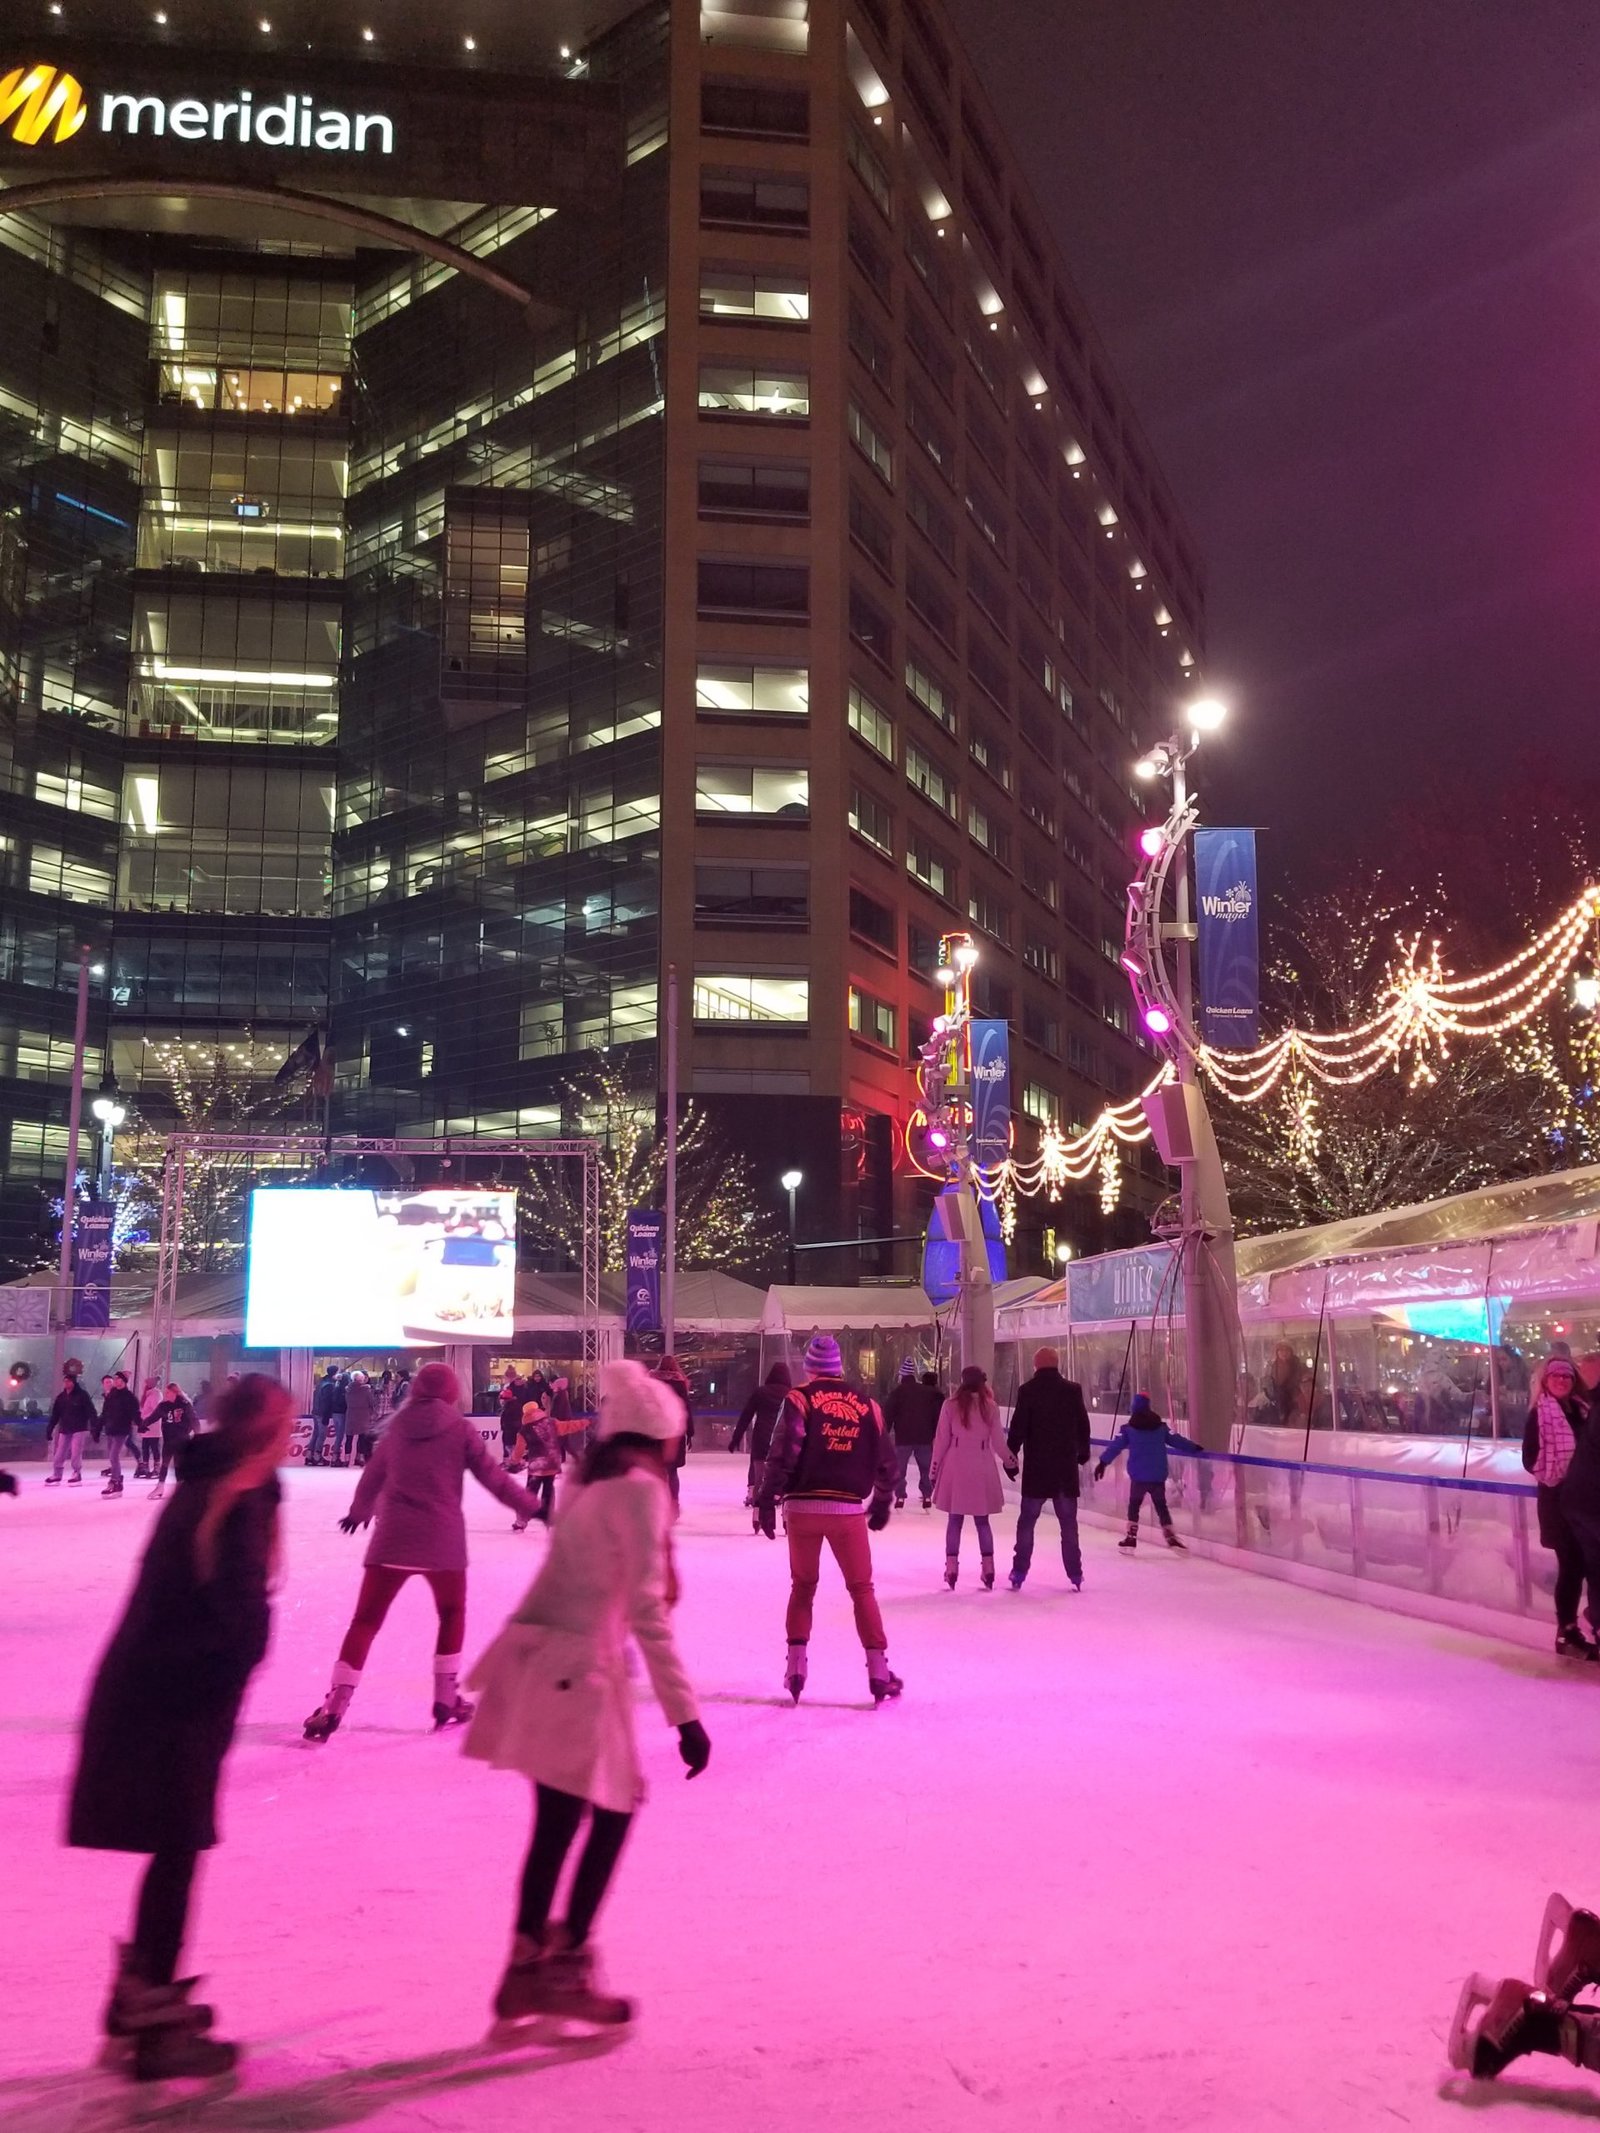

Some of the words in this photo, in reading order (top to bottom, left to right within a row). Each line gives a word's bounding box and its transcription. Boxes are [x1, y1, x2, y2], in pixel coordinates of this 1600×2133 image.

[101, 92, 393, 153] meridian
[1201, 896, 1252, 916] Winter
[1215, 912, 1249, 922] magic
[1205, 1006, 1233, 1014] Quicken
[1233, 1007, 1253, 1015] Loans
[973, 1065, 1006, 1079] Winter
[80, 1215, 113, 1224] Quicken
[629, 1224, 660, 1232] Quicken
[78, 1248, 109, 1260] Winter
[630, 1255, 658, 1268] Winter
[821, 1422, 860, 1438] Football
[827, 1437, 852, 1451] Track
